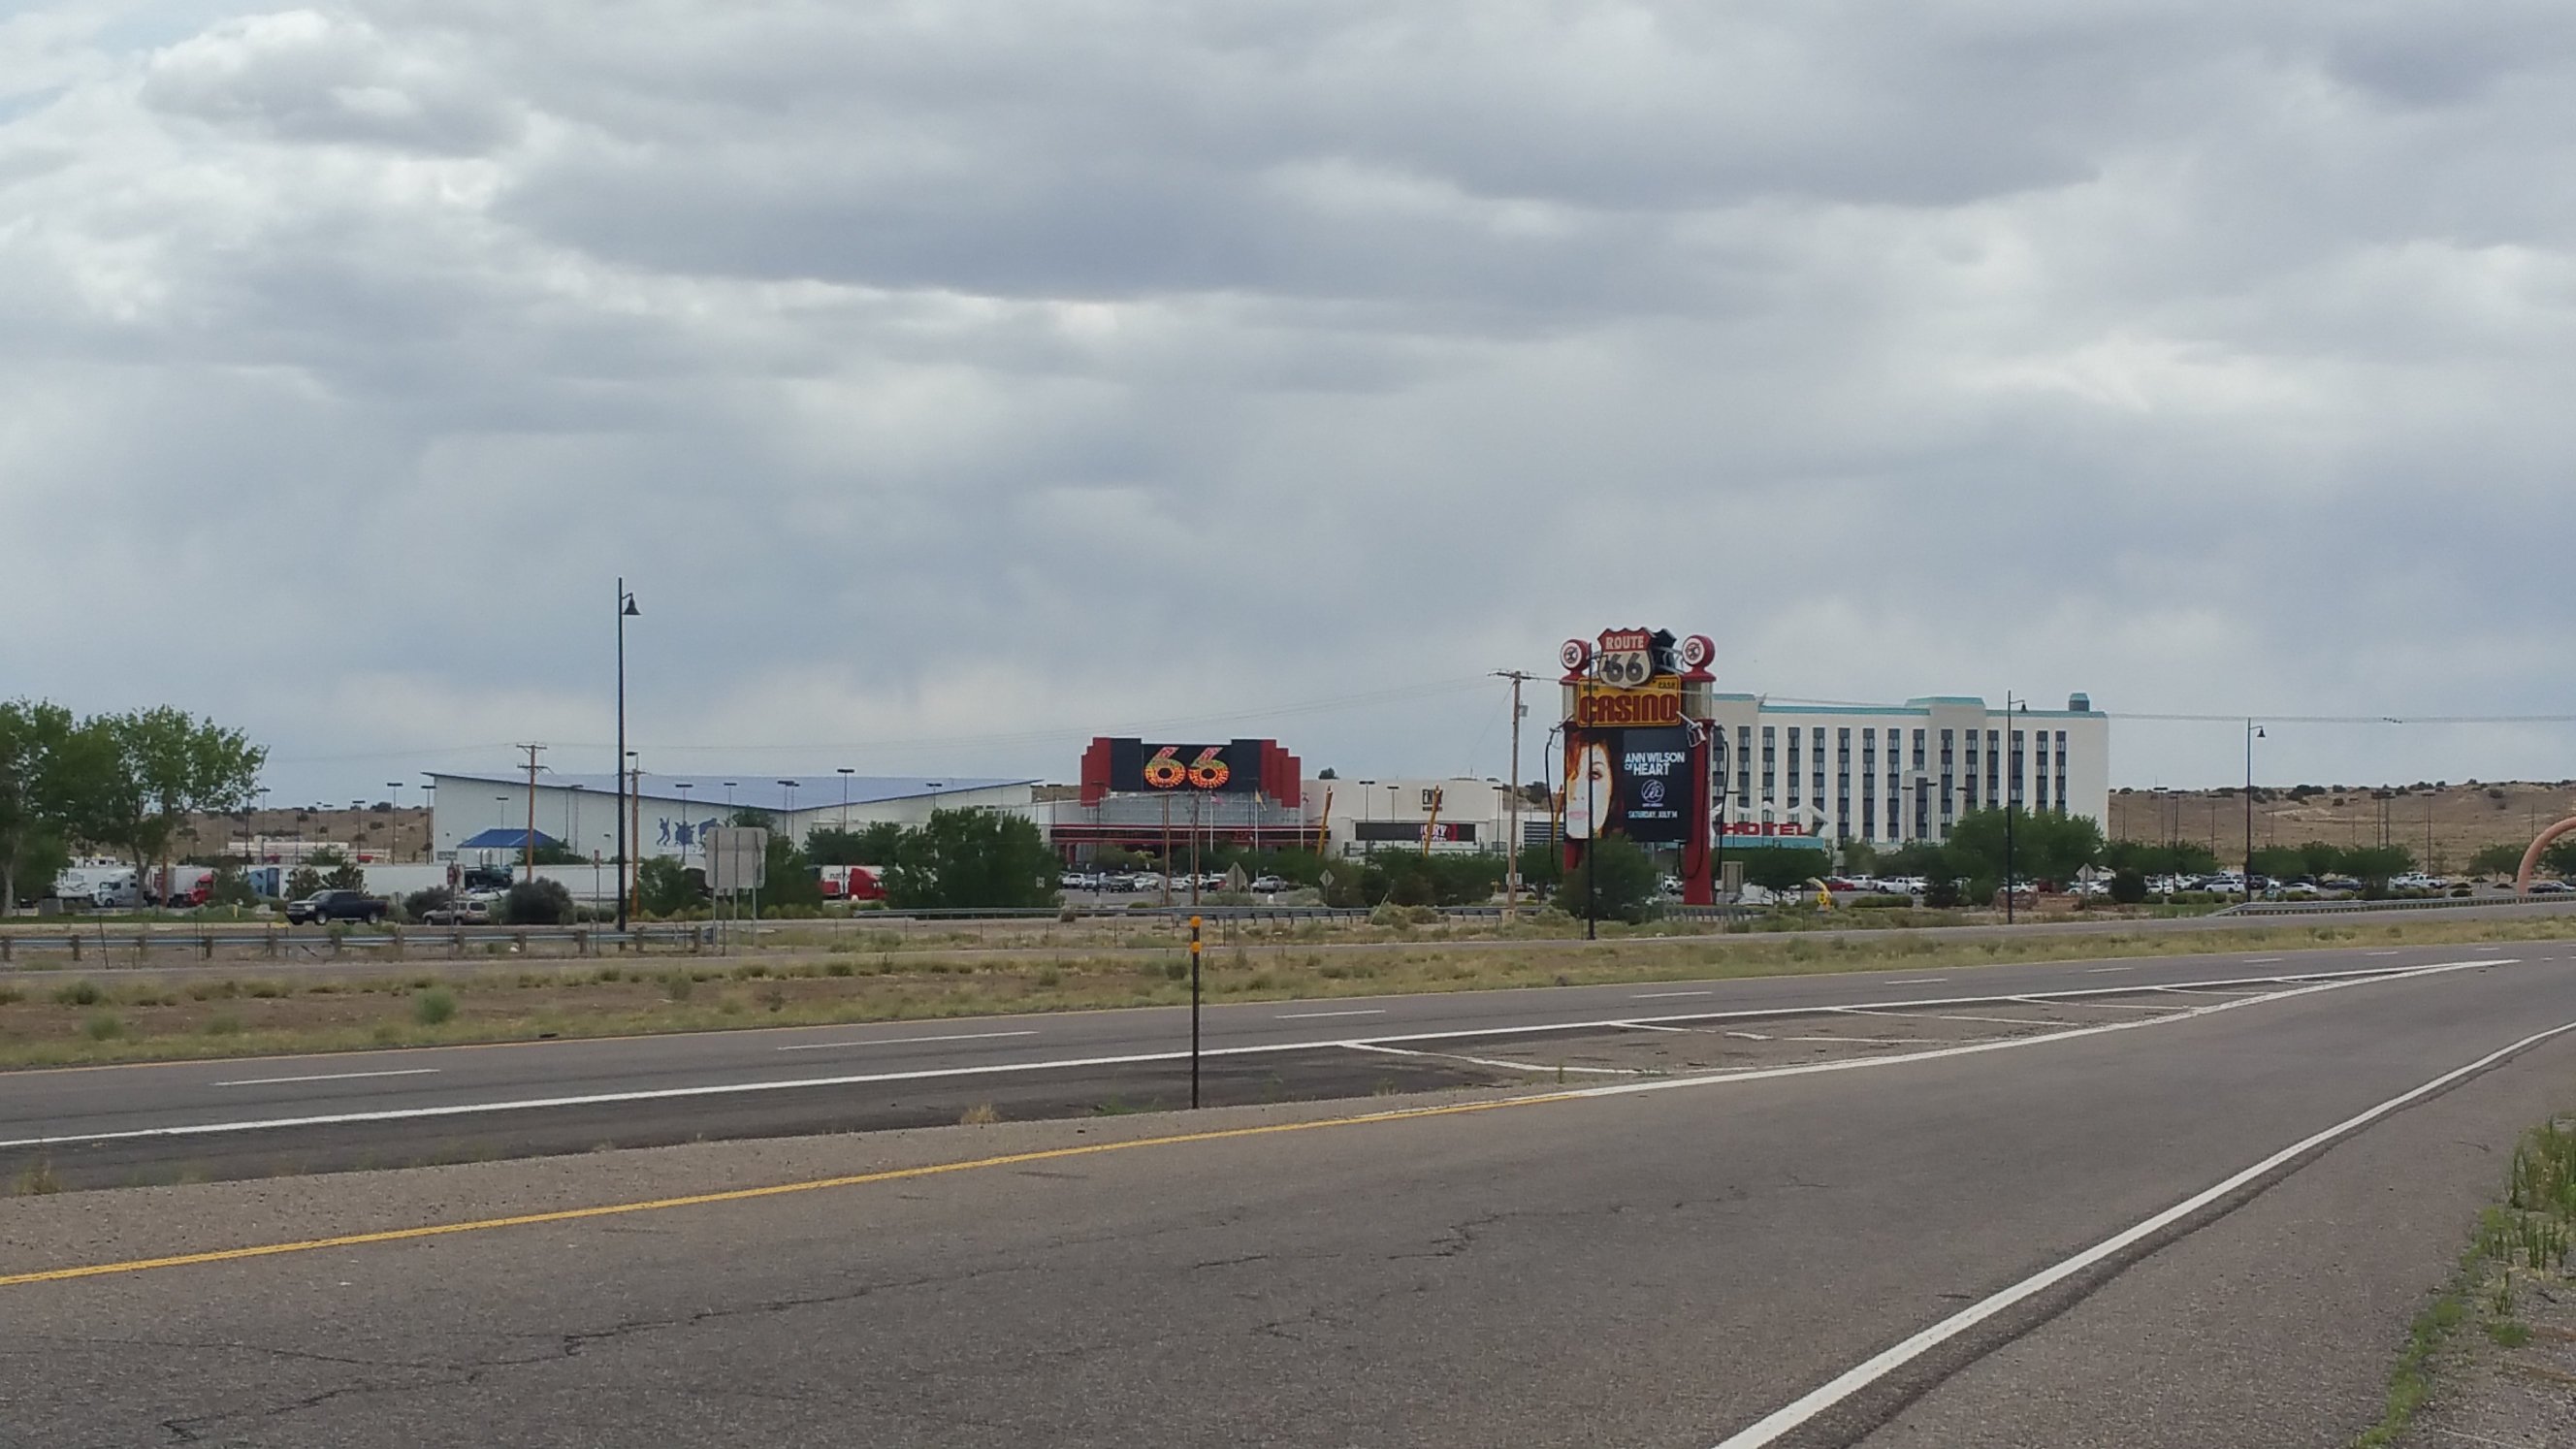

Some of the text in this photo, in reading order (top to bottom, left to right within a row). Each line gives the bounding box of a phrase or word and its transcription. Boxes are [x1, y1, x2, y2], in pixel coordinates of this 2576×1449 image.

[1606, 635, 1644, 649] ROUTE
[1580, 694, 1677, 723] CASINO
[1625, 752, 1686, 763] ANN WILSON
[1144, 746, 1229, 788] 66
[1633, 763, 1670, 776] HEART
[1723, 822, 1811, 836] HOTEL
